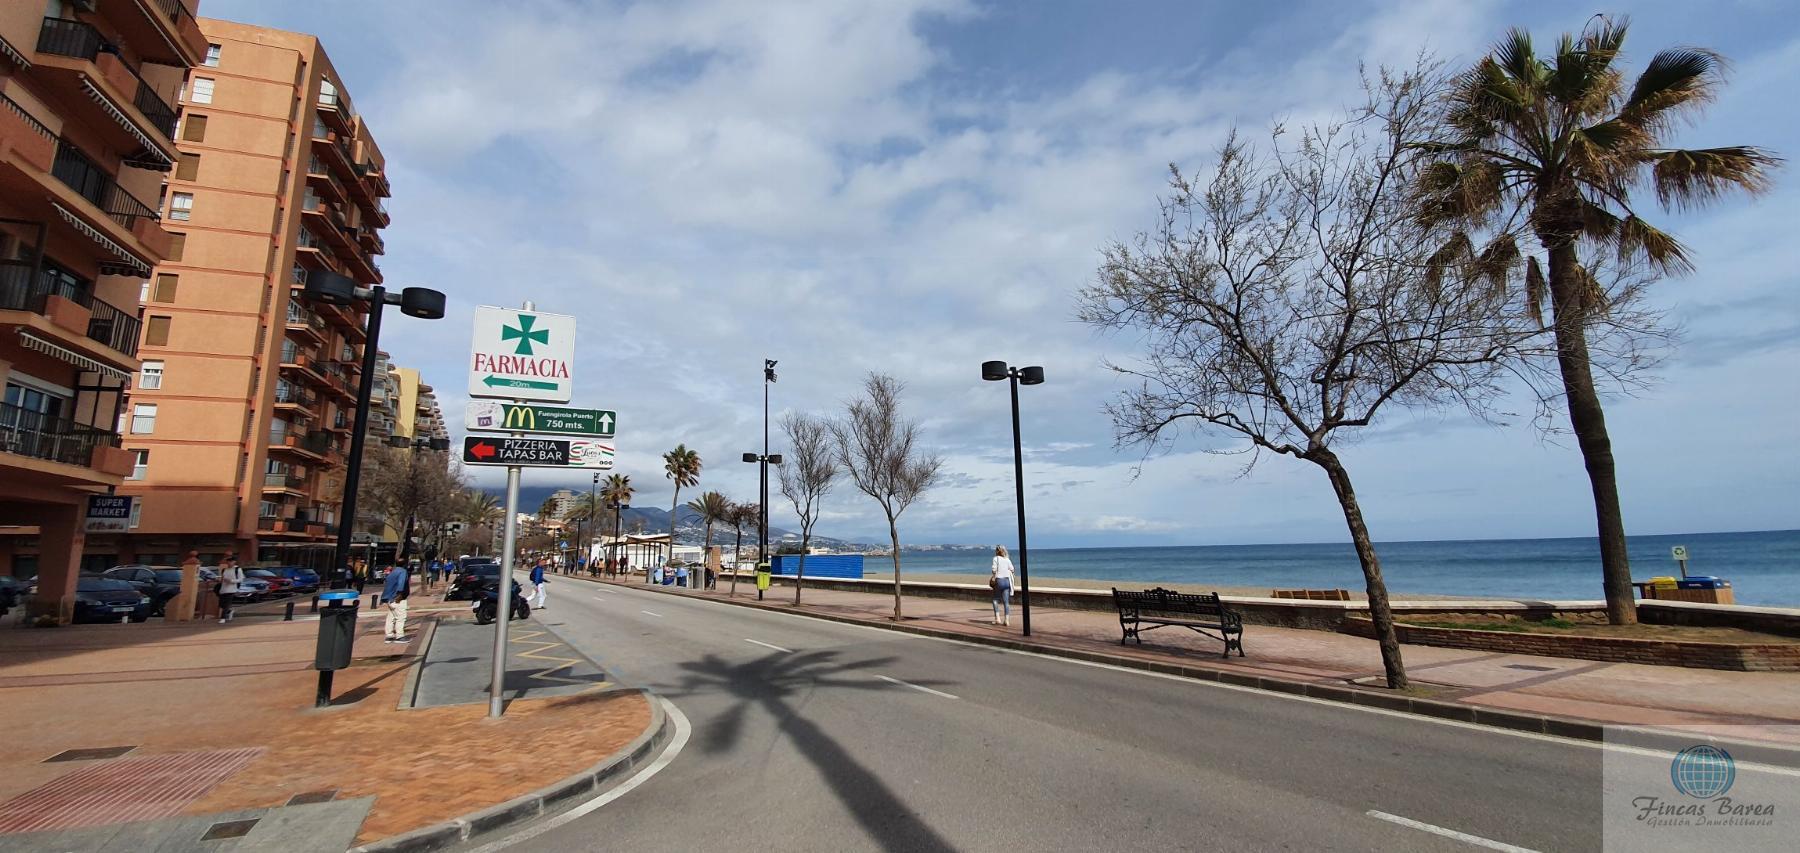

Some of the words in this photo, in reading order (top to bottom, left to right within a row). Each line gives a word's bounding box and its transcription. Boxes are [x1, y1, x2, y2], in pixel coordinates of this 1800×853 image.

[474, 353, 569, 378] FARMACIA
[537, 410, 572, 418] Fuengirola
[546, 419, 564, 428] 750
[565, 421, 585, 430] mts.
[504, 439, 557, 450] PIZZERIA
[499, 448, 537, 460] TAPAS
[539, 450, 563, 460] BAR
[95, 498, 124, 507] SUPER
[90, 508, 126, 516] MARKET
